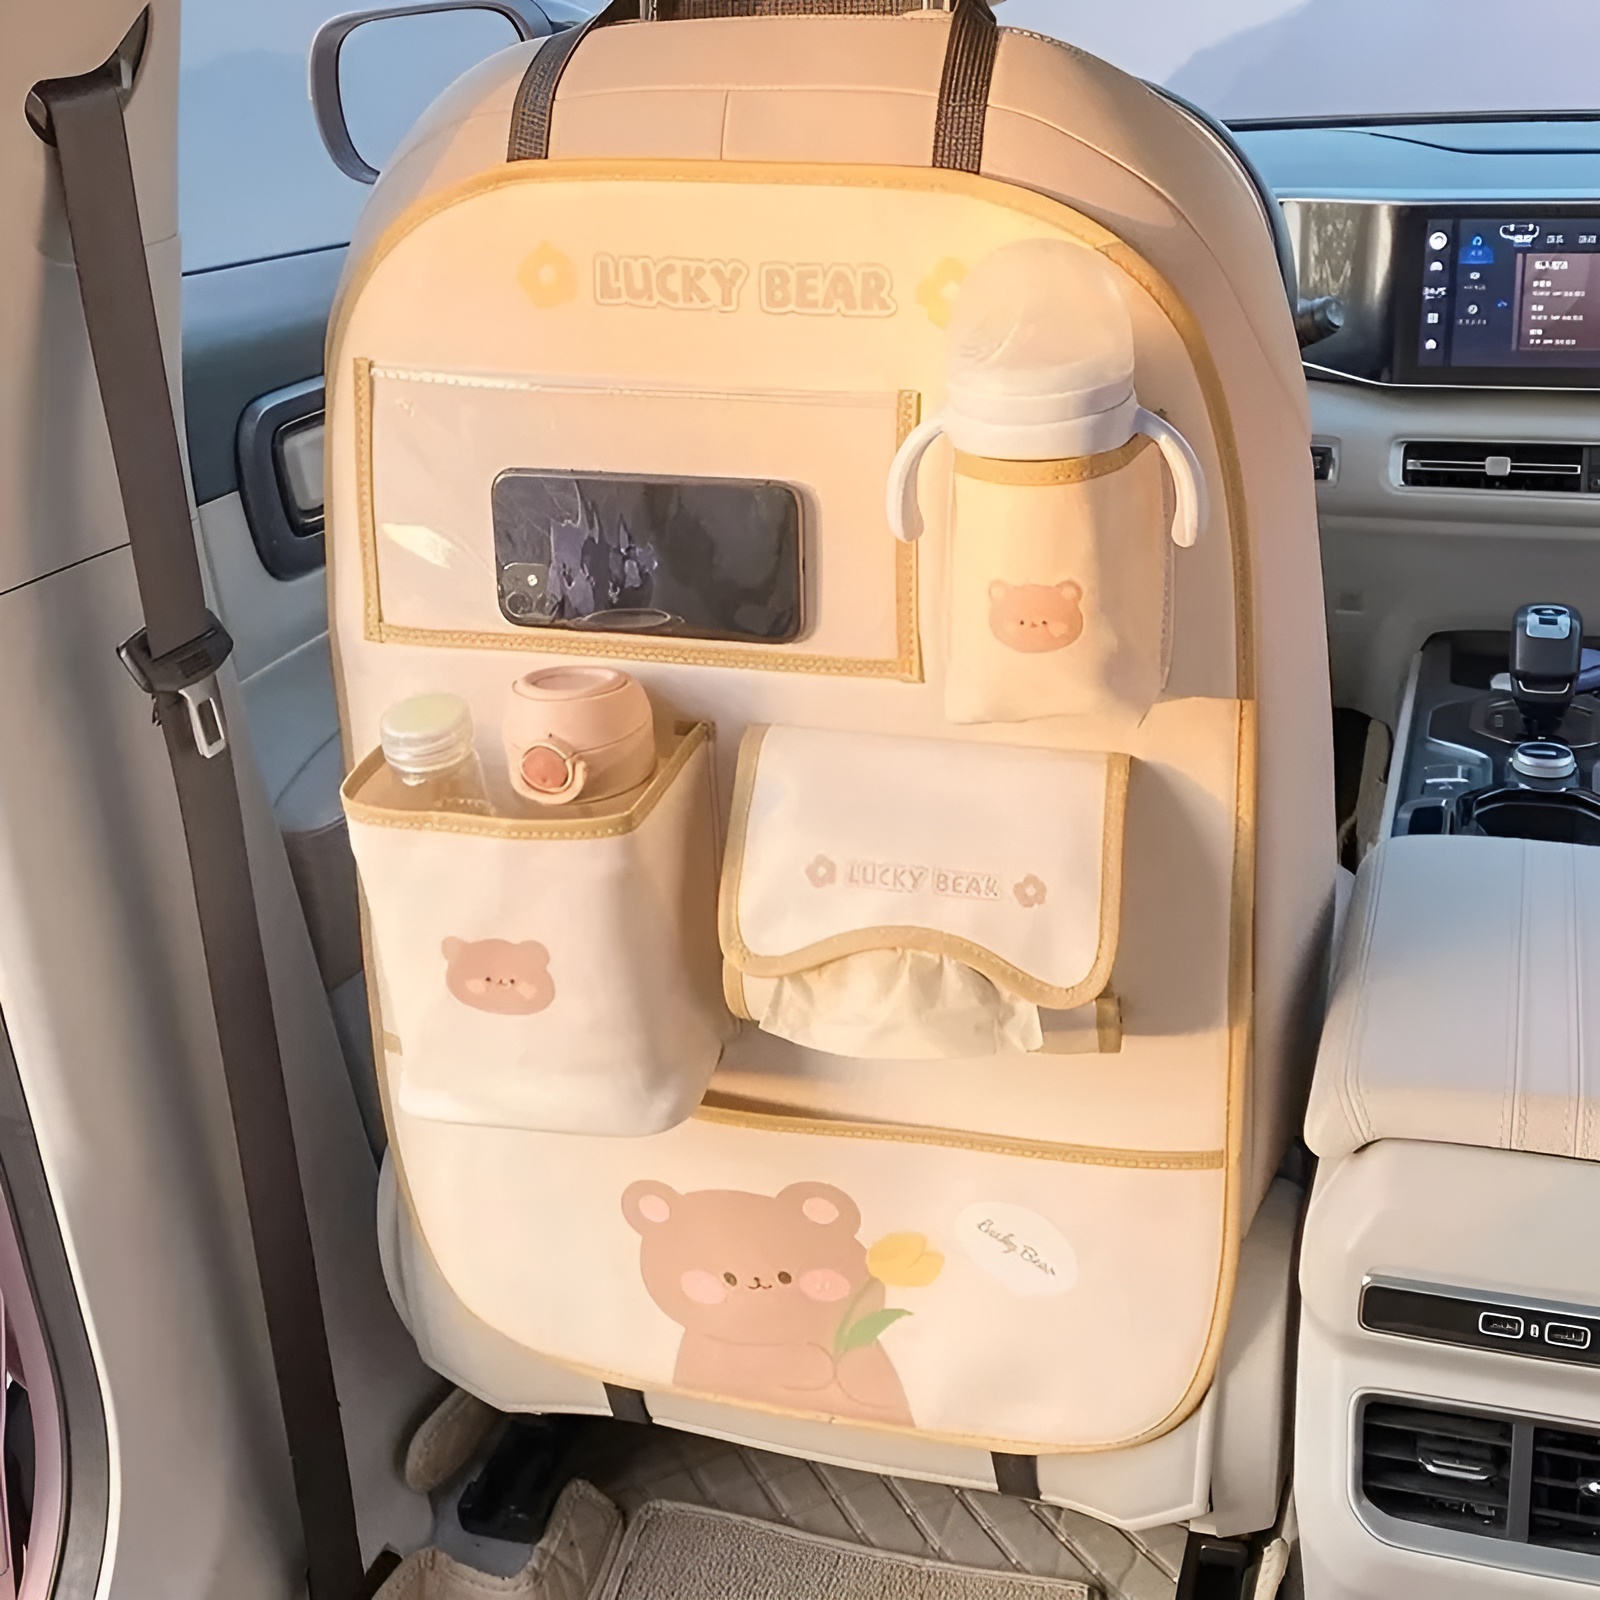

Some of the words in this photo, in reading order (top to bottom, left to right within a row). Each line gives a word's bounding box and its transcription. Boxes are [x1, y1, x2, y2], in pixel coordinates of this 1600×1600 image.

[595, 253, 748, 312] LUCKY
[760, 261, 896, 316] BEAR
[846, 861, 927, 892] LUCKY
[932, 869, 1000, 900] BEAR
